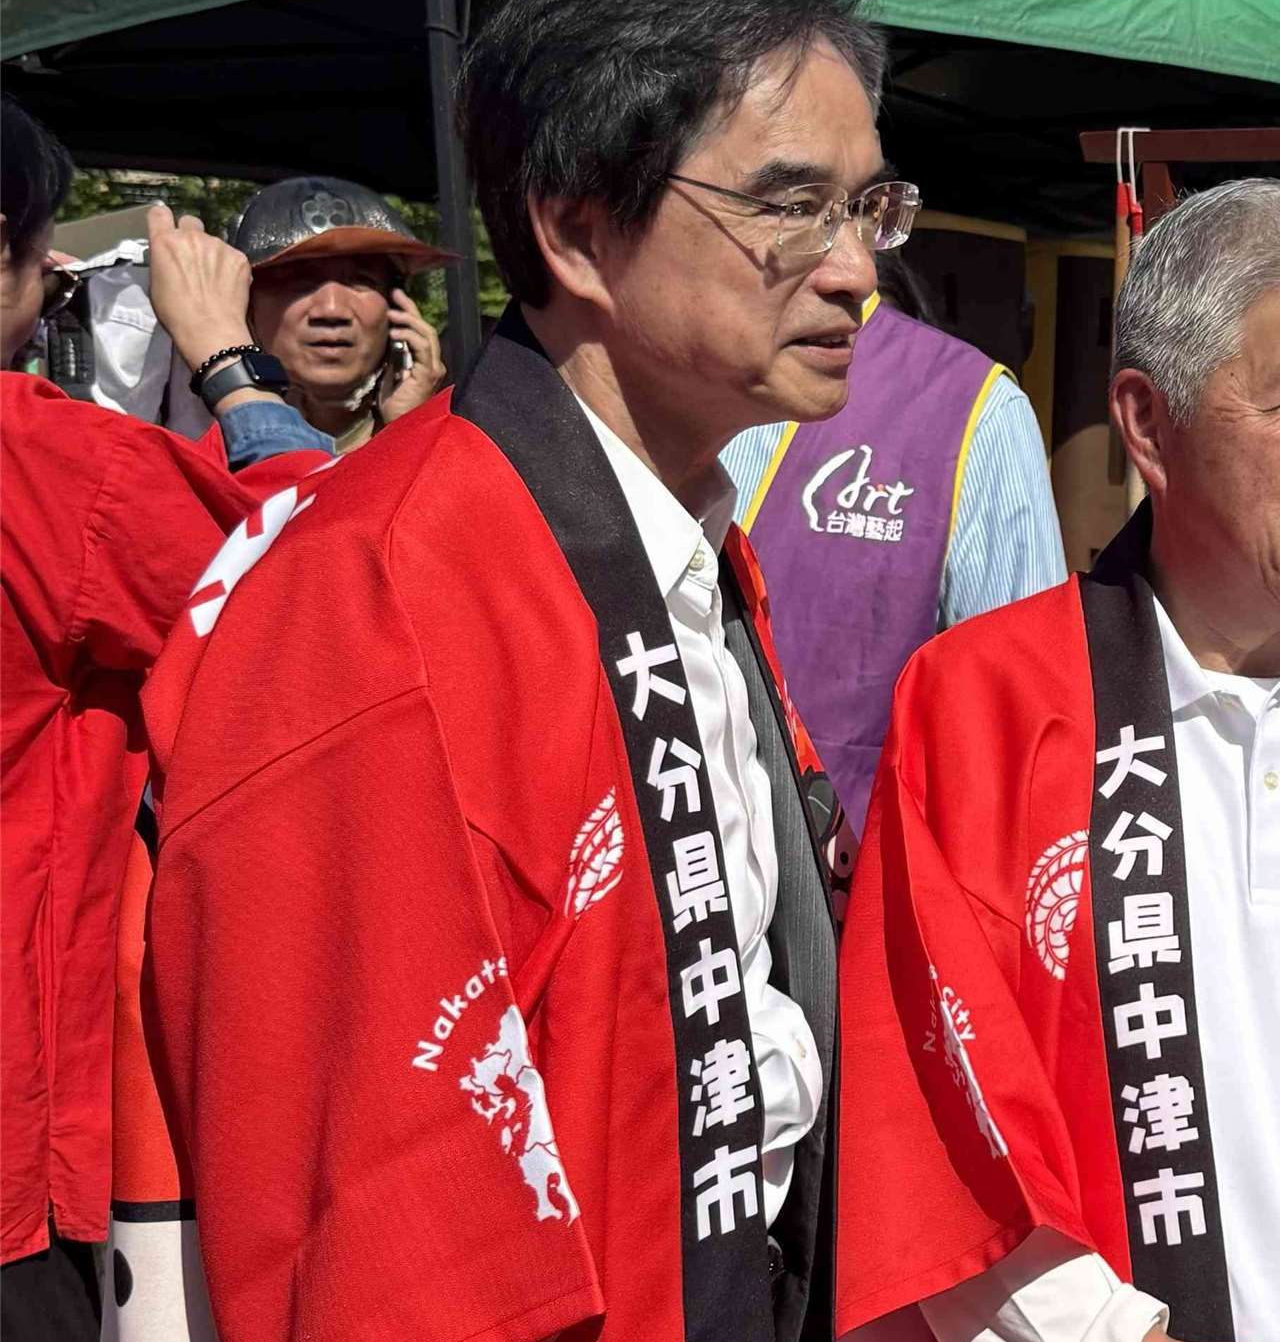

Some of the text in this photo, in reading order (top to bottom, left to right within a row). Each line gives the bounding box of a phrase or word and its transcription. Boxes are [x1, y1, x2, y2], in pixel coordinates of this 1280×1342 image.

[826, 510, 904, 542] 台灣藝起
[616, 631, 759, 1243] 大分県中津市
[1096, 724, 1207, 1247] 大分県中津市
